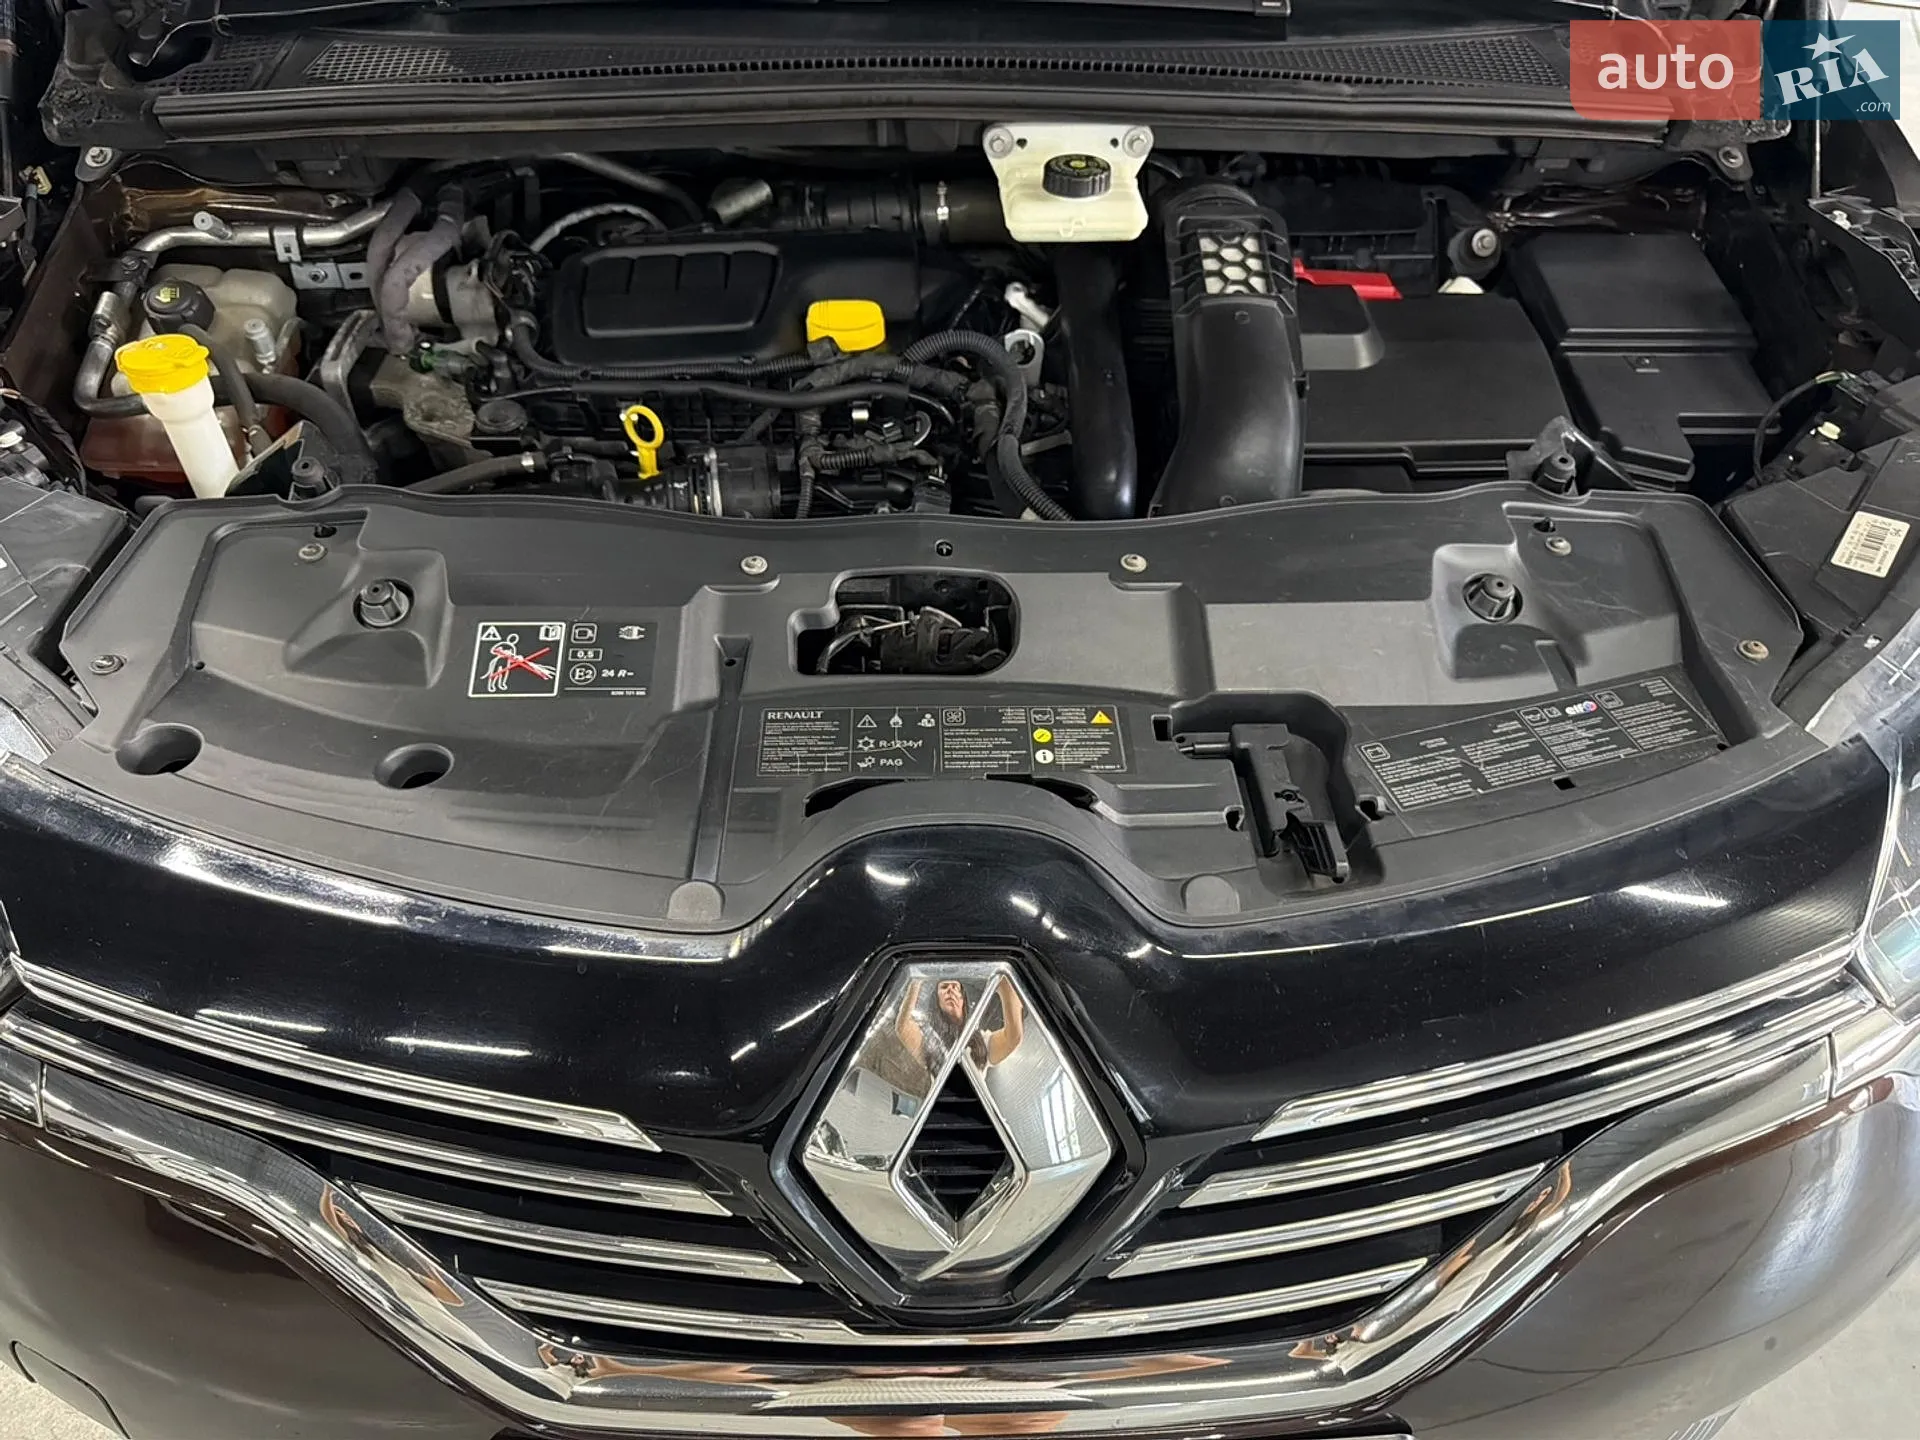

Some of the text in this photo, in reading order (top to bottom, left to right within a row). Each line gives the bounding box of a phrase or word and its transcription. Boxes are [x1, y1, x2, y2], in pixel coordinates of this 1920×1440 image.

[574, 667, 593, 680] E2
[601, 669, 615, 677] 24
[767, 711, 824, 720] RENAULT
[879, 739, 923, 748] R-1234yf
[880, 758, 903, 766] PAG
